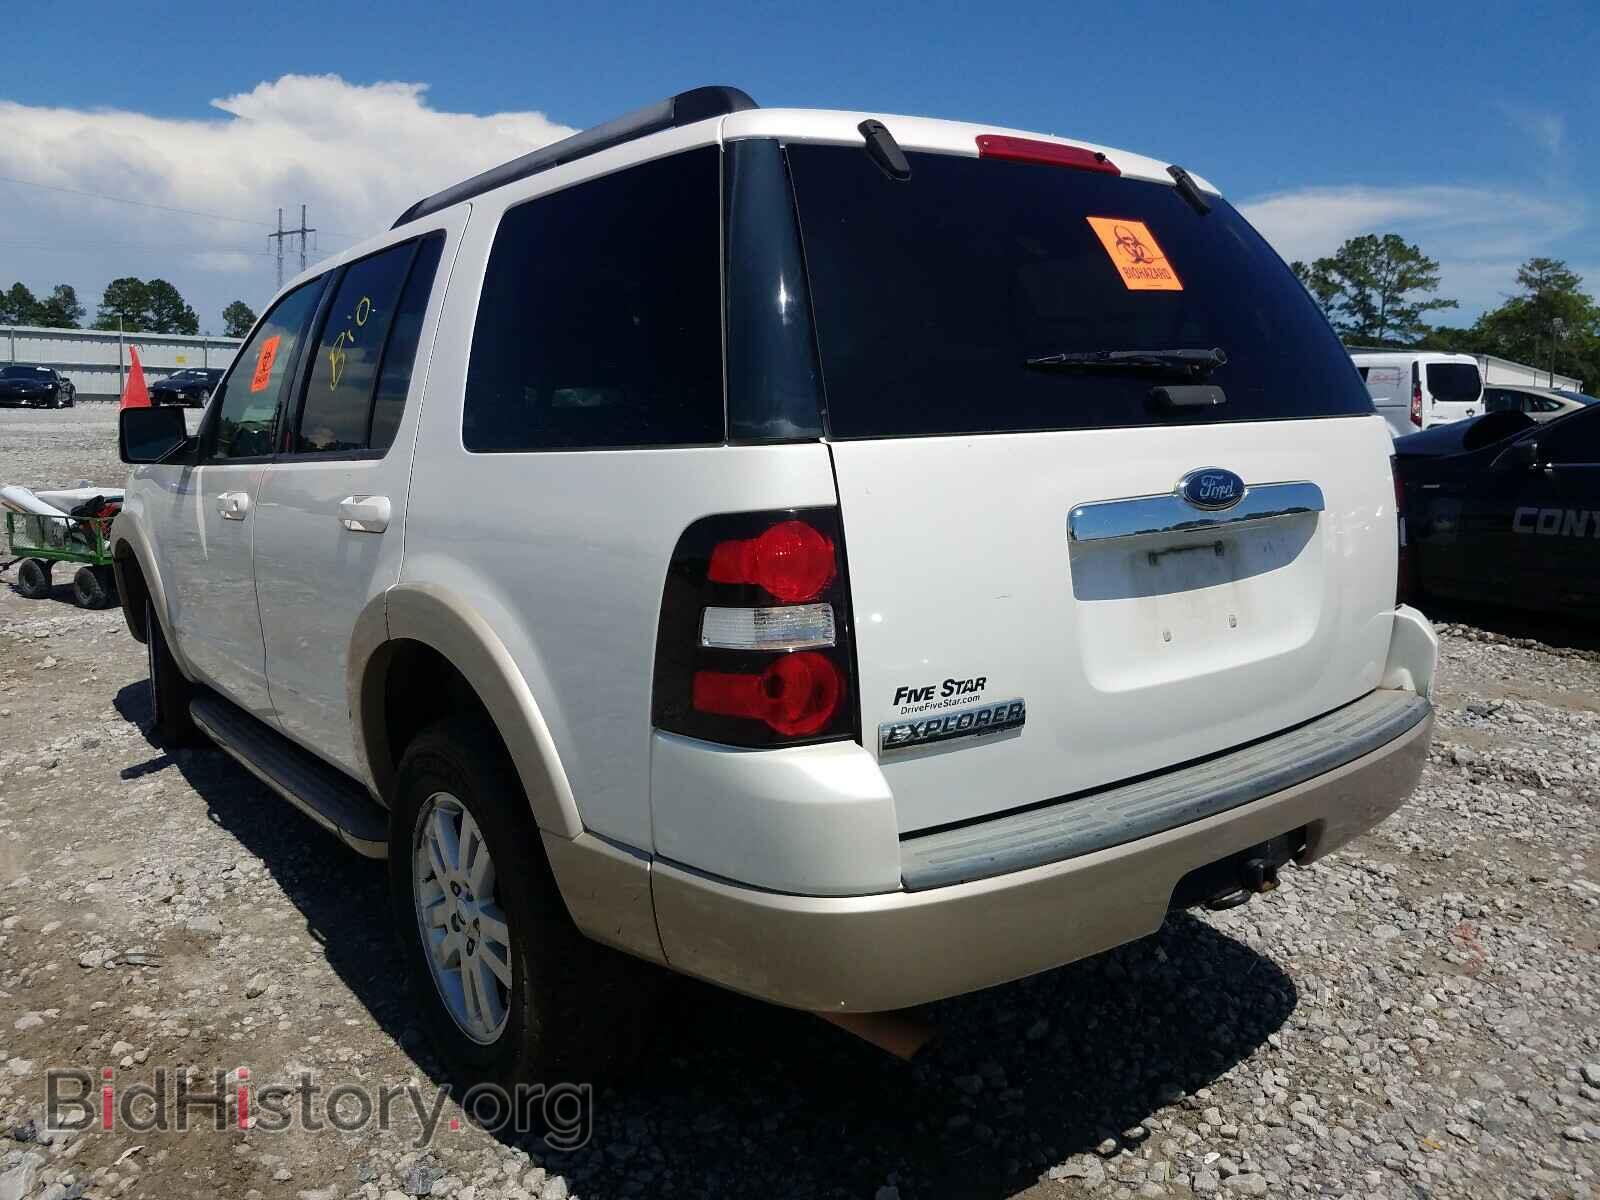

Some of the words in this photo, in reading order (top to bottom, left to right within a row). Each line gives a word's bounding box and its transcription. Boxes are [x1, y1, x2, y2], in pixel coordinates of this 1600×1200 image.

[1122, 266, 1172, 280] BIOHAZARD
[1199, 474, 1234, 499] Ford
[900, 694, 981, 715] DriveFiveStar.com
[886, 702, 1025, 745] EXPLORER
